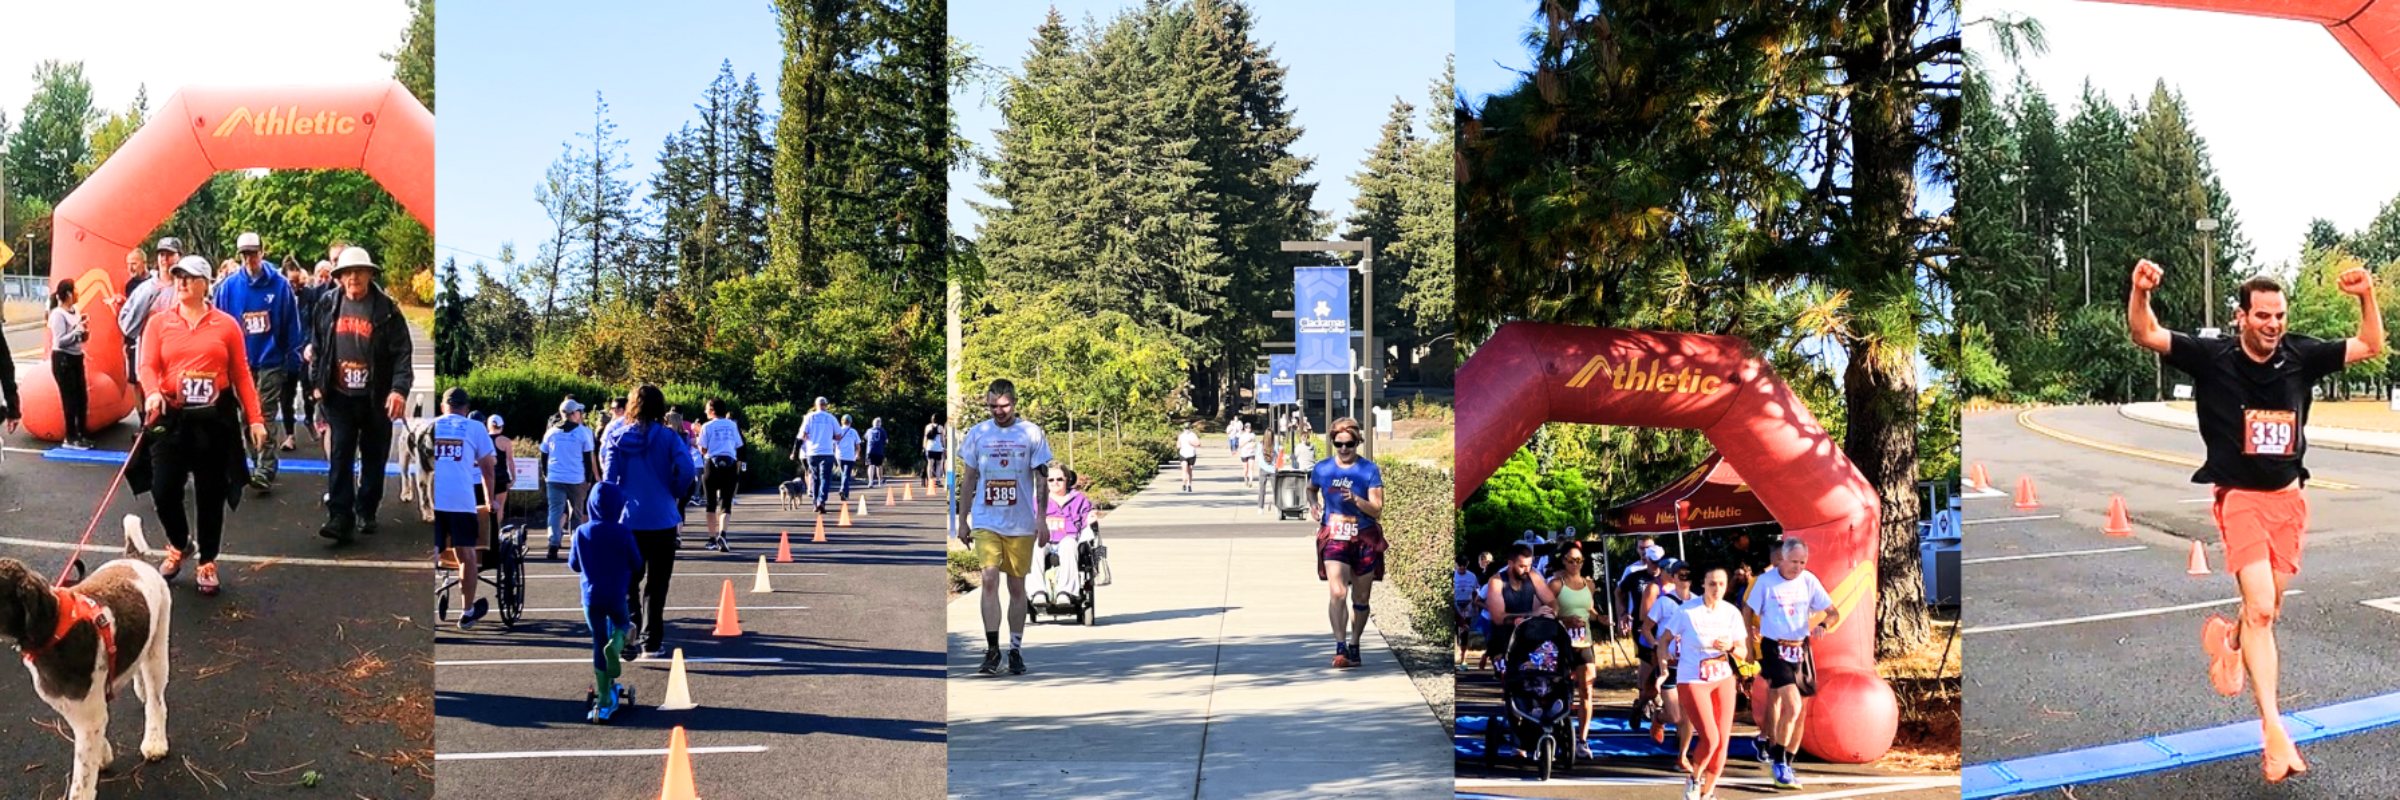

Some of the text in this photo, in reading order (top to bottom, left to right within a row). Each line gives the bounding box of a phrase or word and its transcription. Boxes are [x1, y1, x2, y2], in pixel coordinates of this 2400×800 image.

[211, 105, 357, 138] Athletic
[344, 368, 369, 383] 382
[1565, 354, 1722, 395] Athletic
[182, 378, 214, 397] 375
[2251, 421, 2291, 446] 339
[435, 443, 463, 456] 1138
[985, 487, 1016, 500] 1389
[1329, 521, 1359, 537] 1395
